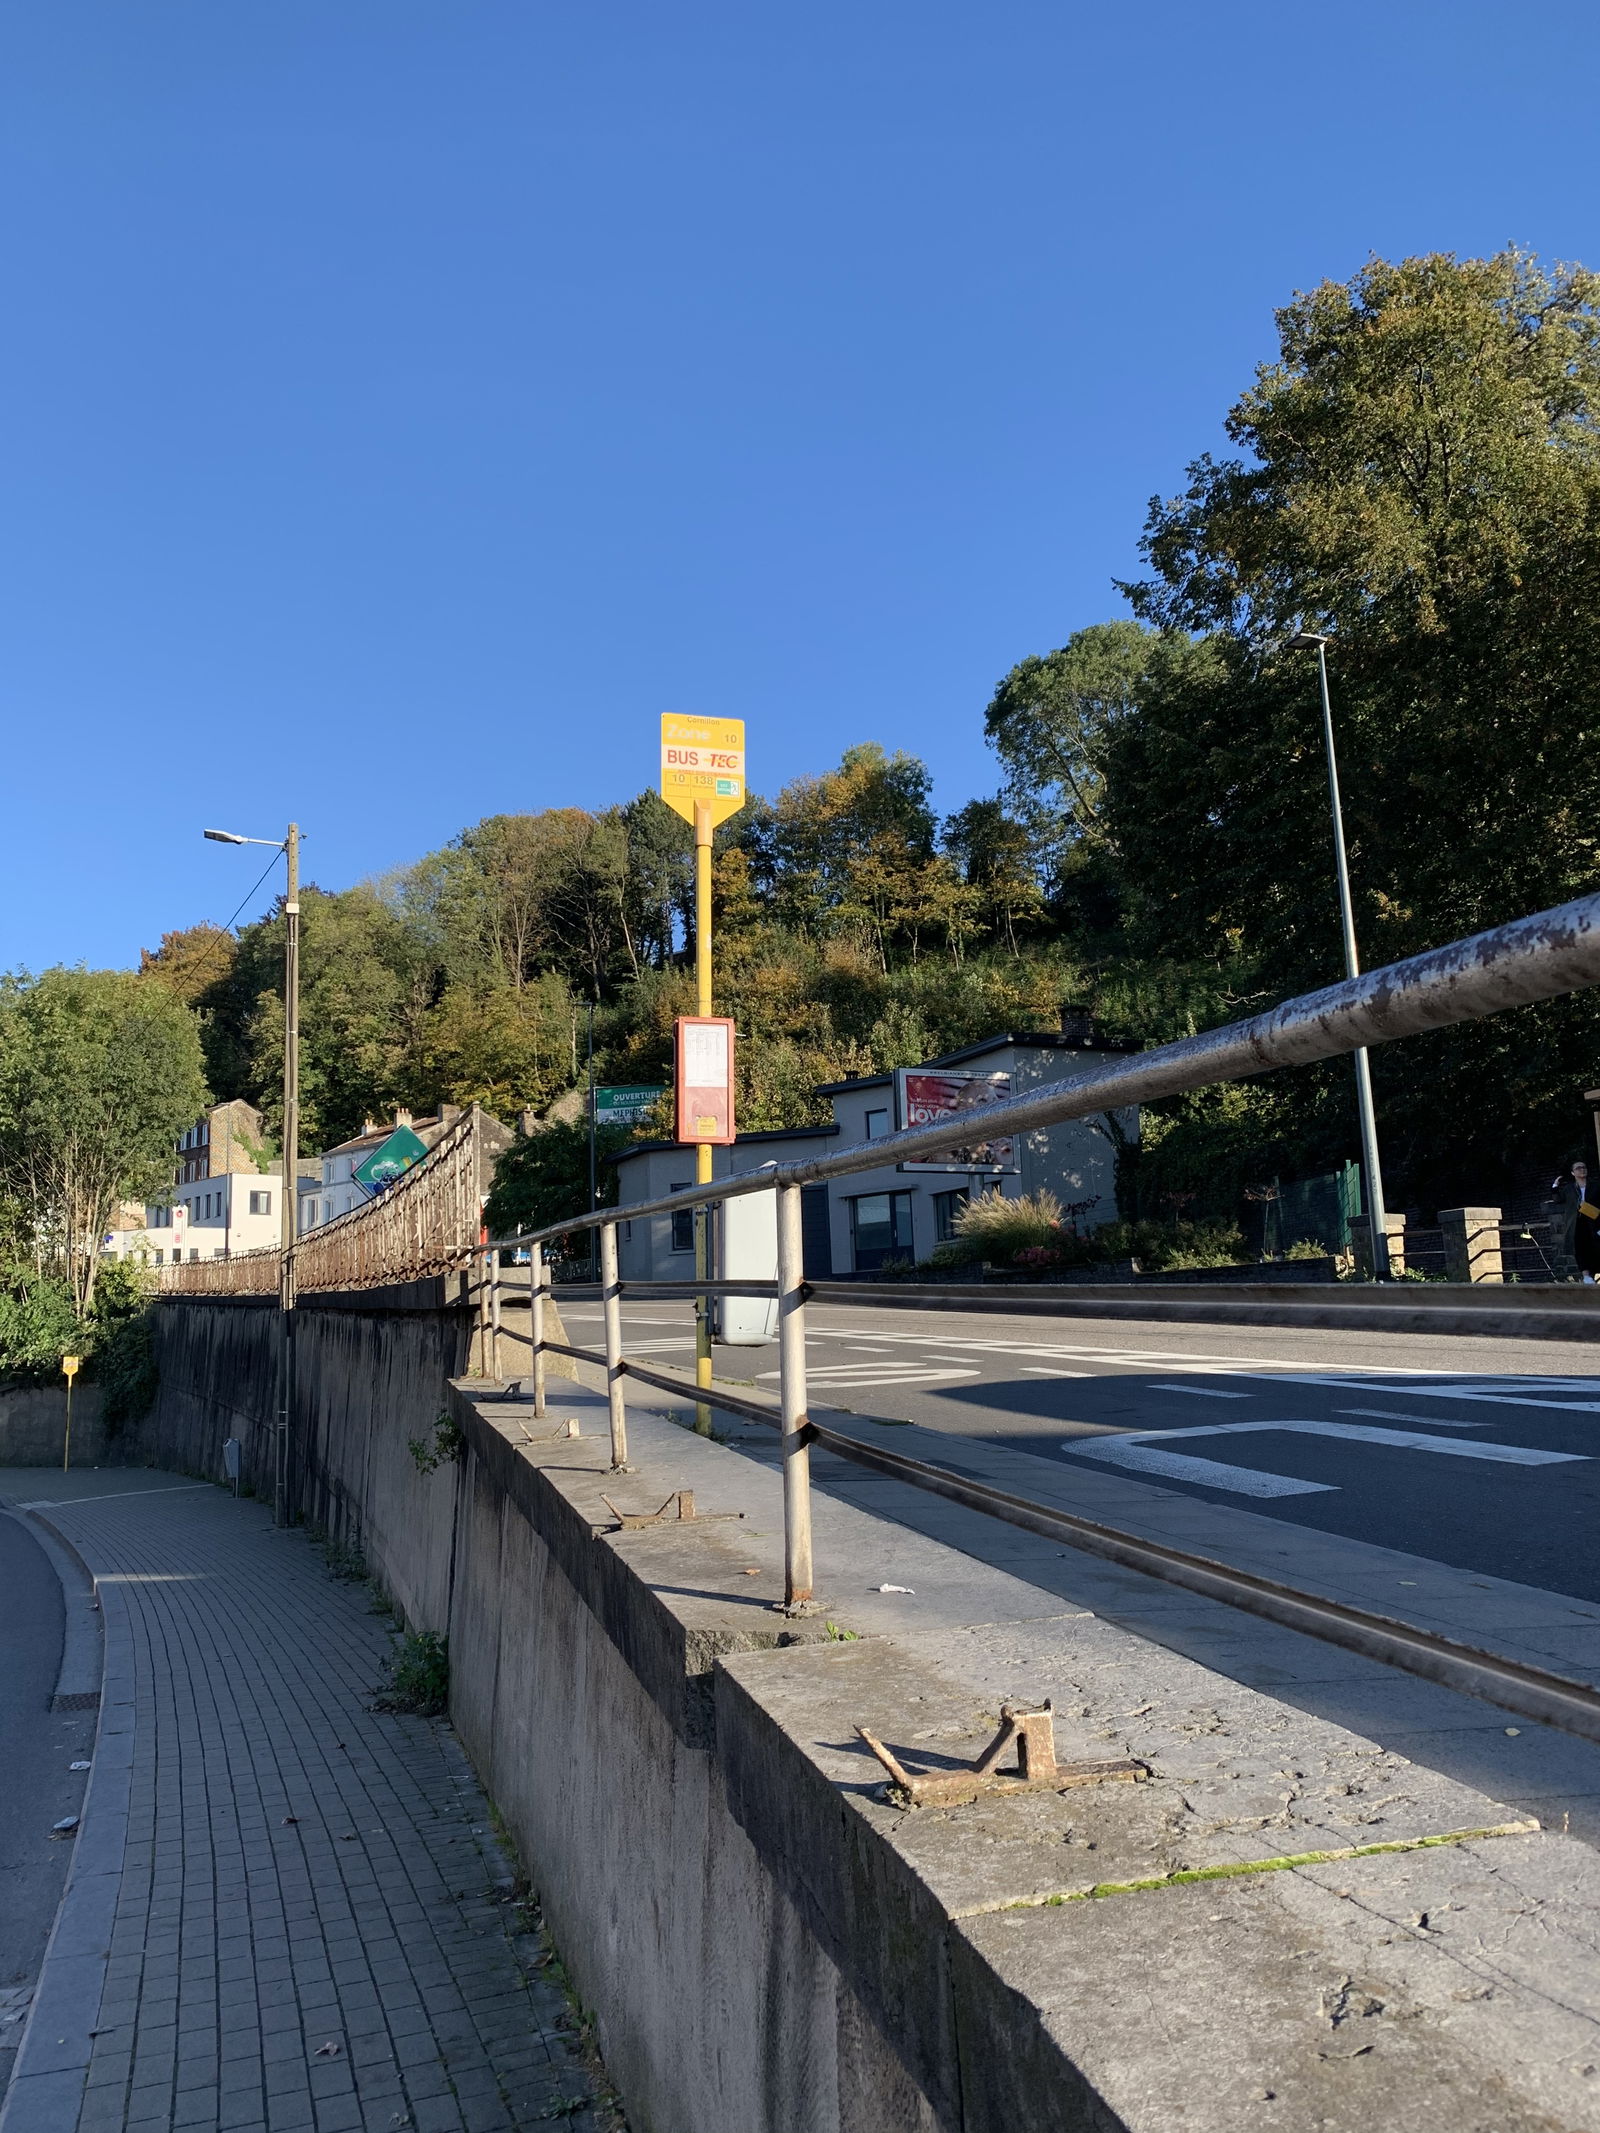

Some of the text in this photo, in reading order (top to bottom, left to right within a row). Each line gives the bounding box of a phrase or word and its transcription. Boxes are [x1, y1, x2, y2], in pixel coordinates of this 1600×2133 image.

[666, 724, 737, 743] Zone 10
[667, 750, 738, 769] BUS TEC
[673, 774, 714, 786] 10 138
